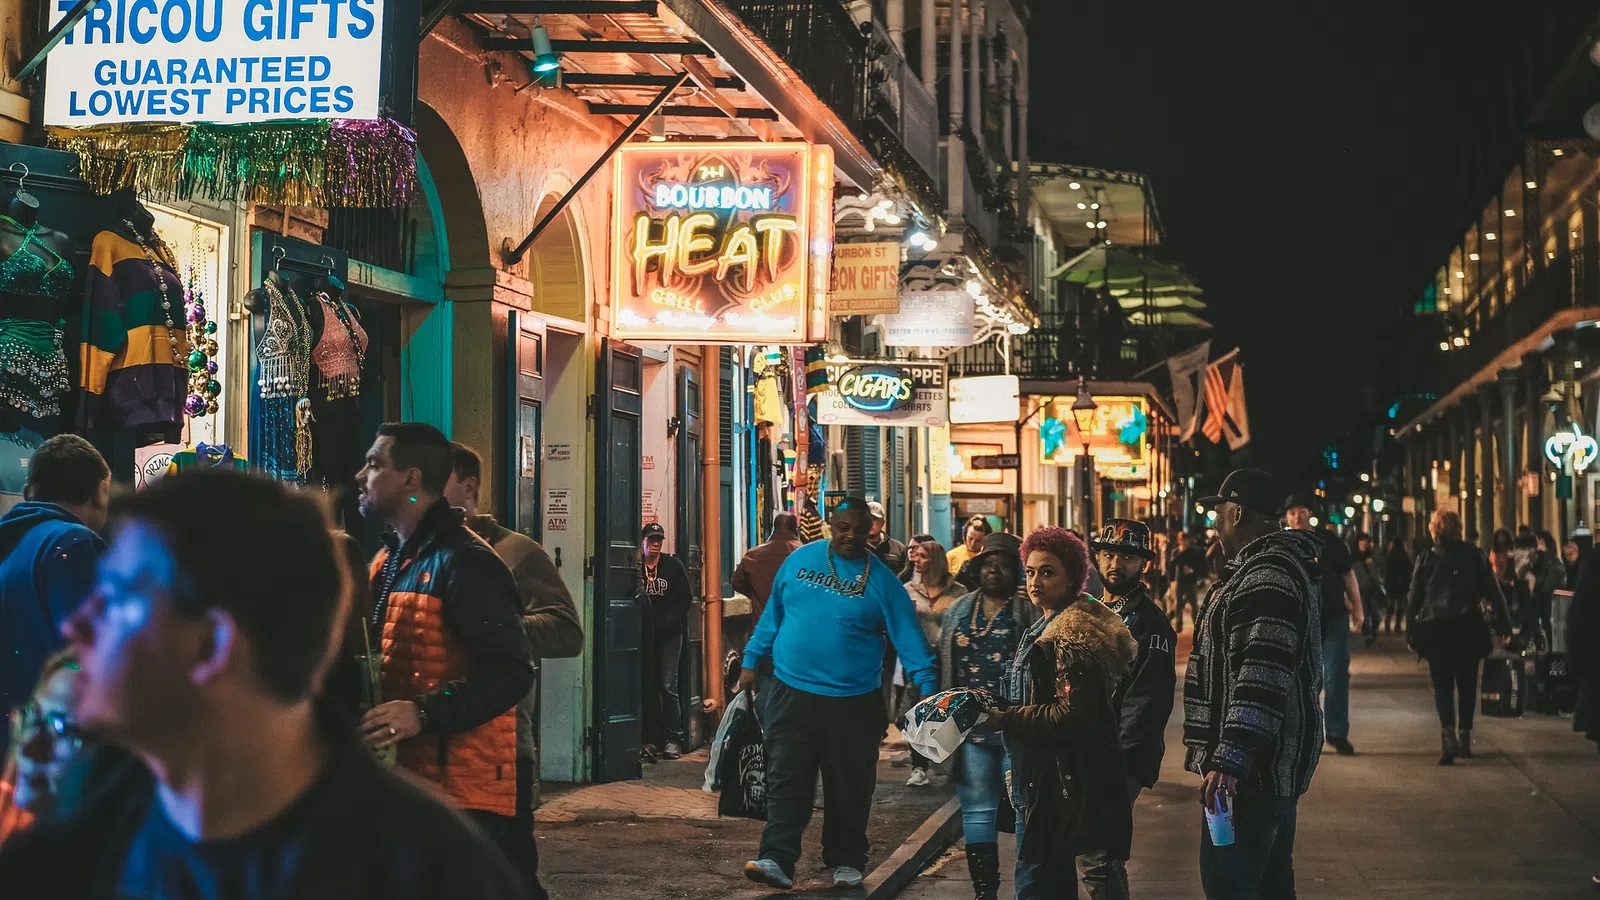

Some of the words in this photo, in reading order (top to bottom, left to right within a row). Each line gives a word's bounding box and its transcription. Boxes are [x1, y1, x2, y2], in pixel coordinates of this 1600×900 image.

[243, 0, 375, 43] GIFTS
[94, 55, 332, 86] GUARANTEED
[69, 88, 214, 117] LOWEST
[225, 85, 355, 114] PRICES
[655, 184, 772, 209] BOURBON
[632, 212, 798, 297] HEAT
[874, 246, 888, 257] ST
[861, 265, 898, 290] GIFTS
[650, 288, 706, 315] GRILL
[749, 283, 795, 313] CLUB
[840, 374, 913, 400] CIGARS
[548, 518, 567, 526] ATM
